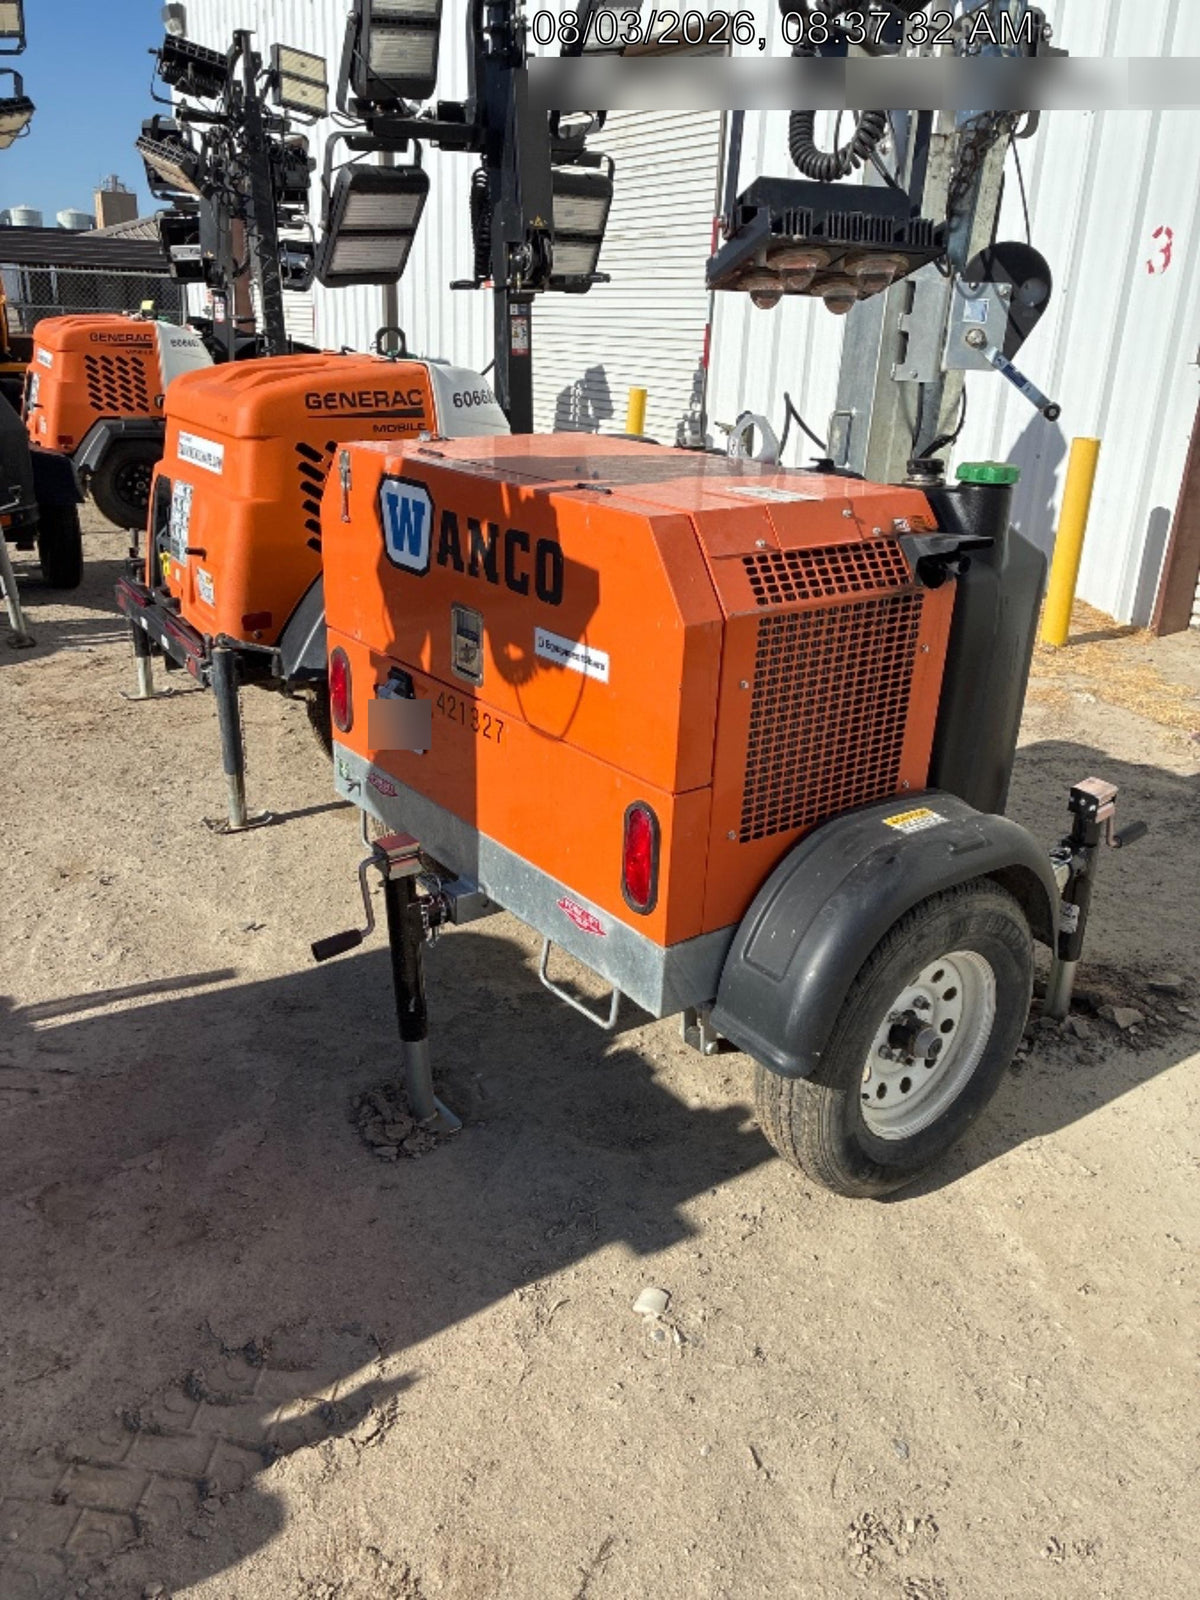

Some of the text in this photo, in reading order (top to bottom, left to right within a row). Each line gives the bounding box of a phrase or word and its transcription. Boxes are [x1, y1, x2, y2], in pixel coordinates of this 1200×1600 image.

[1147, 225, 1173, 275] 3
[89, 332, 154, 343] GENERAC
[304, 389, 424, 411] GENERAC
[372, 422, 427, 434] MOBILE
[385, 491, 564, 607] WANCO
[436, 691, 504, 744] 421327
